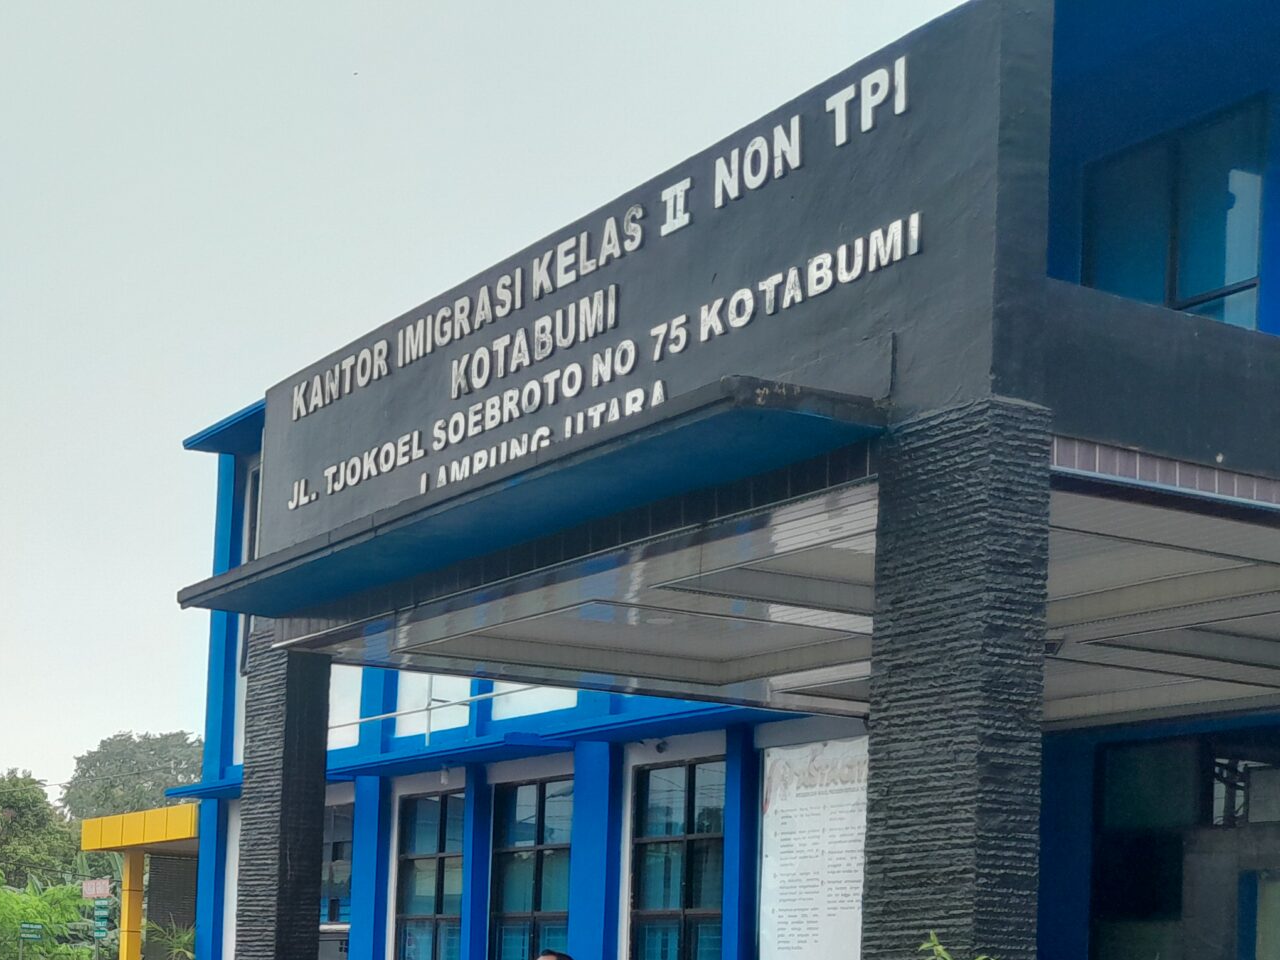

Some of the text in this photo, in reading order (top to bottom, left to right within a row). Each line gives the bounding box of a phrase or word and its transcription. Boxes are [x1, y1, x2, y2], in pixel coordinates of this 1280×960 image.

[287, 212, 921, 510] JL. TJOKOEL SOEBROTO NO 75 KOTABUMI
[290, 54, 908, 421] KANTOR IMIGRASI KELAS II NON TPI
[450, 285, 619, 399] KOTABUMI
